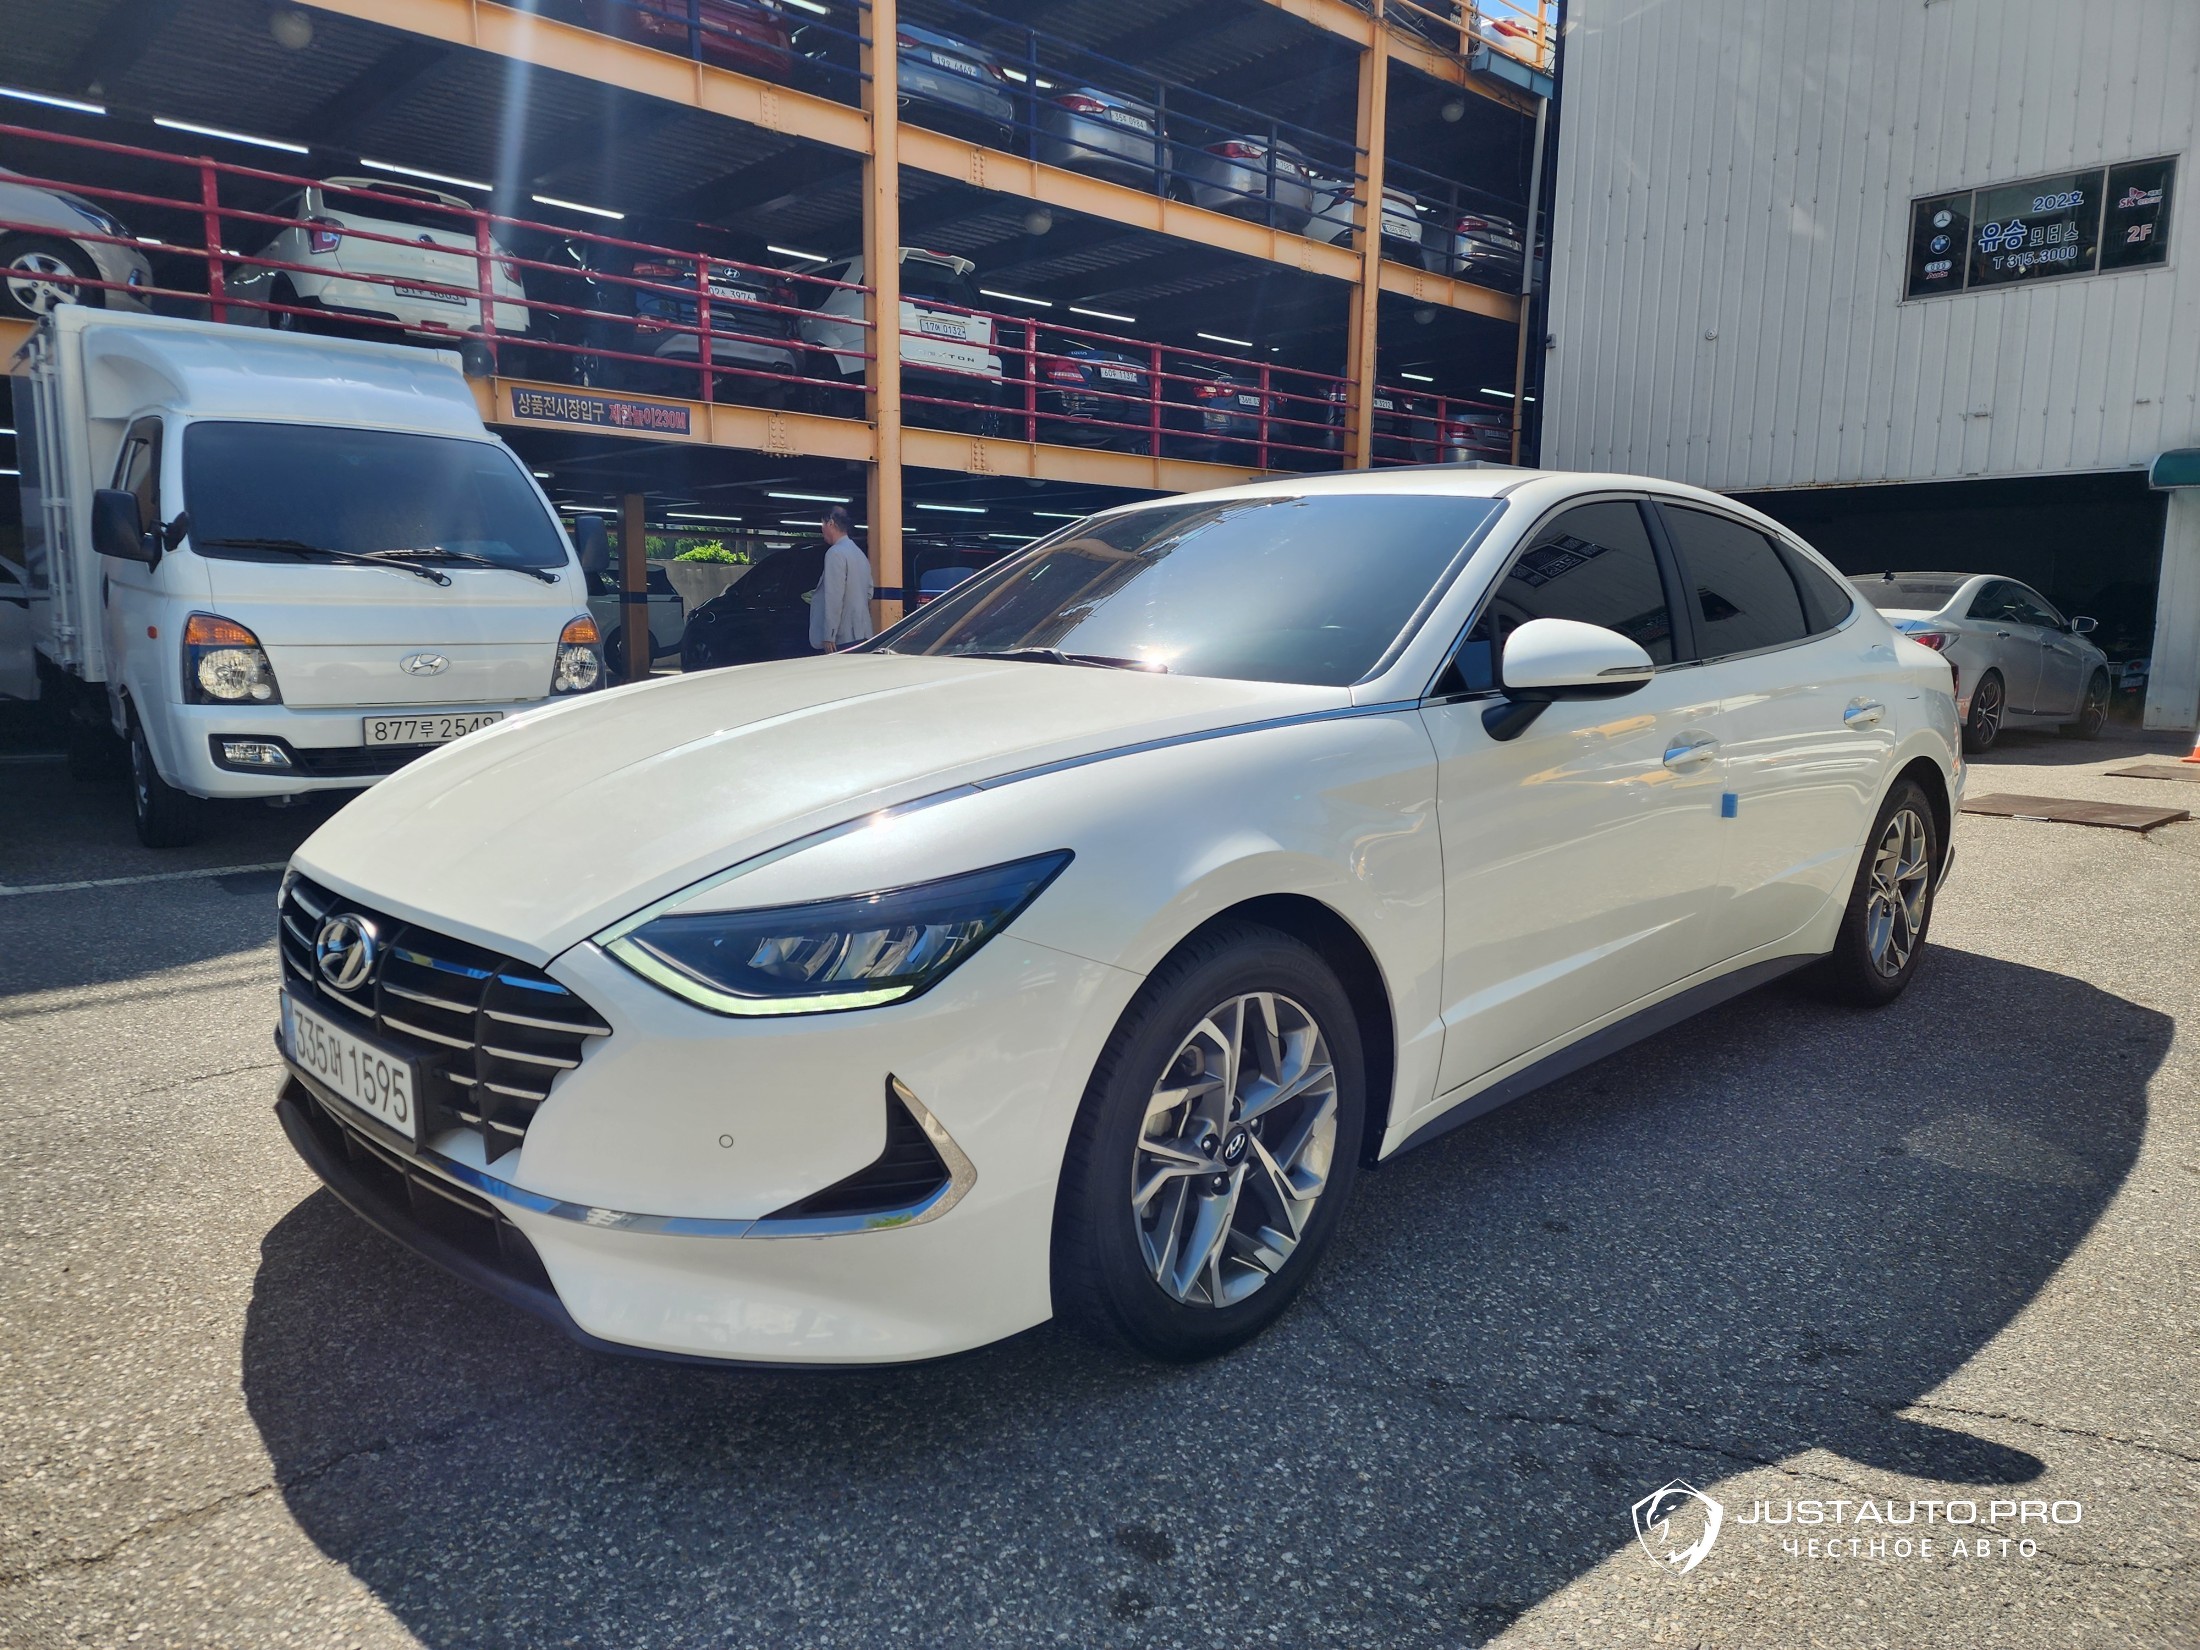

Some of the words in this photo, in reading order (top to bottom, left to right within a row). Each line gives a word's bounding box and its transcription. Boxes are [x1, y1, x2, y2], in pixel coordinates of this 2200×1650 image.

[2032, 190, 2084, 212] 202호
[2118, 197, 2135, 208] SK
[1978, 219, 2028, 253] 유승
[2029, 221, 2079, 247] 모터스
[2127, 223, 2153, 243] 2F
[1992, 256, 2004, 270] T
[2006, 245, 2078, 268] 315.3000
[943, 324, 962, 336] 0132
[518, 393, 605, 422] 상품전시장입구
[375, 720, 434, 741] 877루
[294, 1009, 343, 1085] 335머
[349, 1045, 408, 1123] 1595
